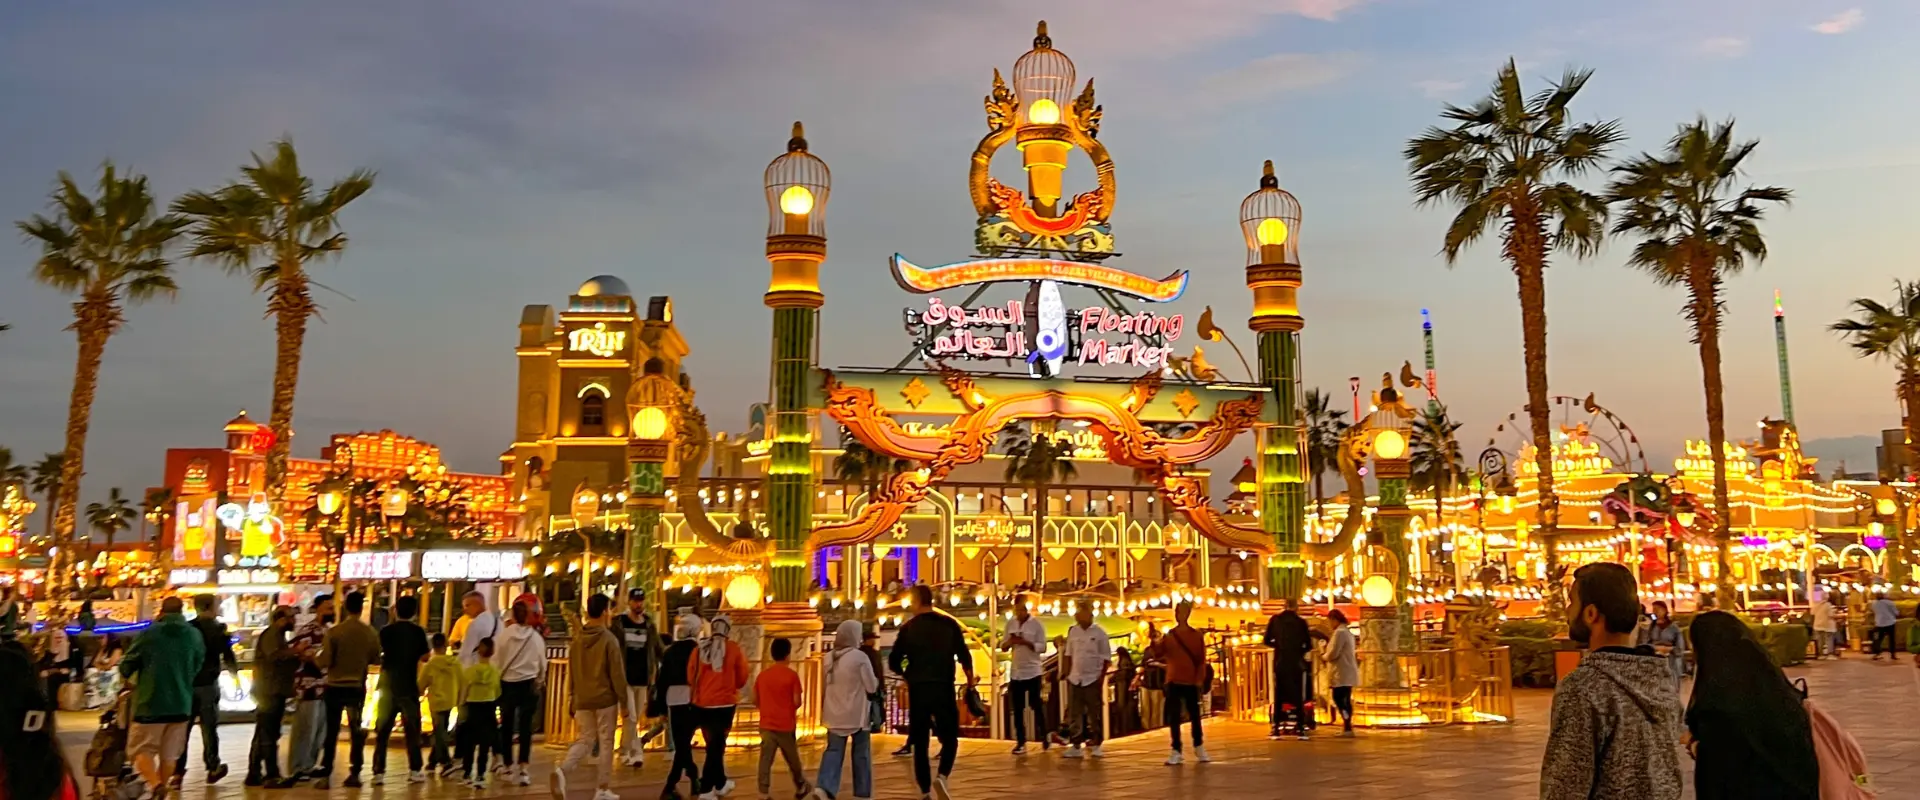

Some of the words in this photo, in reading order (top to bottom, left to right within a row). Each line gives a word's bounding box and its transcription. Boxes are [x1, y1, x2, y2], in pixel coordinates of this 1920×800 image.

[1052, 264, 1087, 277] GLOBAL
[1087, 268, 1125, 284] VILLAGE
[922, 297, 1025, 327] السوق
[1078, 306, 1184, 341] Floating
[930, 328, 1025, 356] العائم
[1078, 339, 1174, 367] Market
